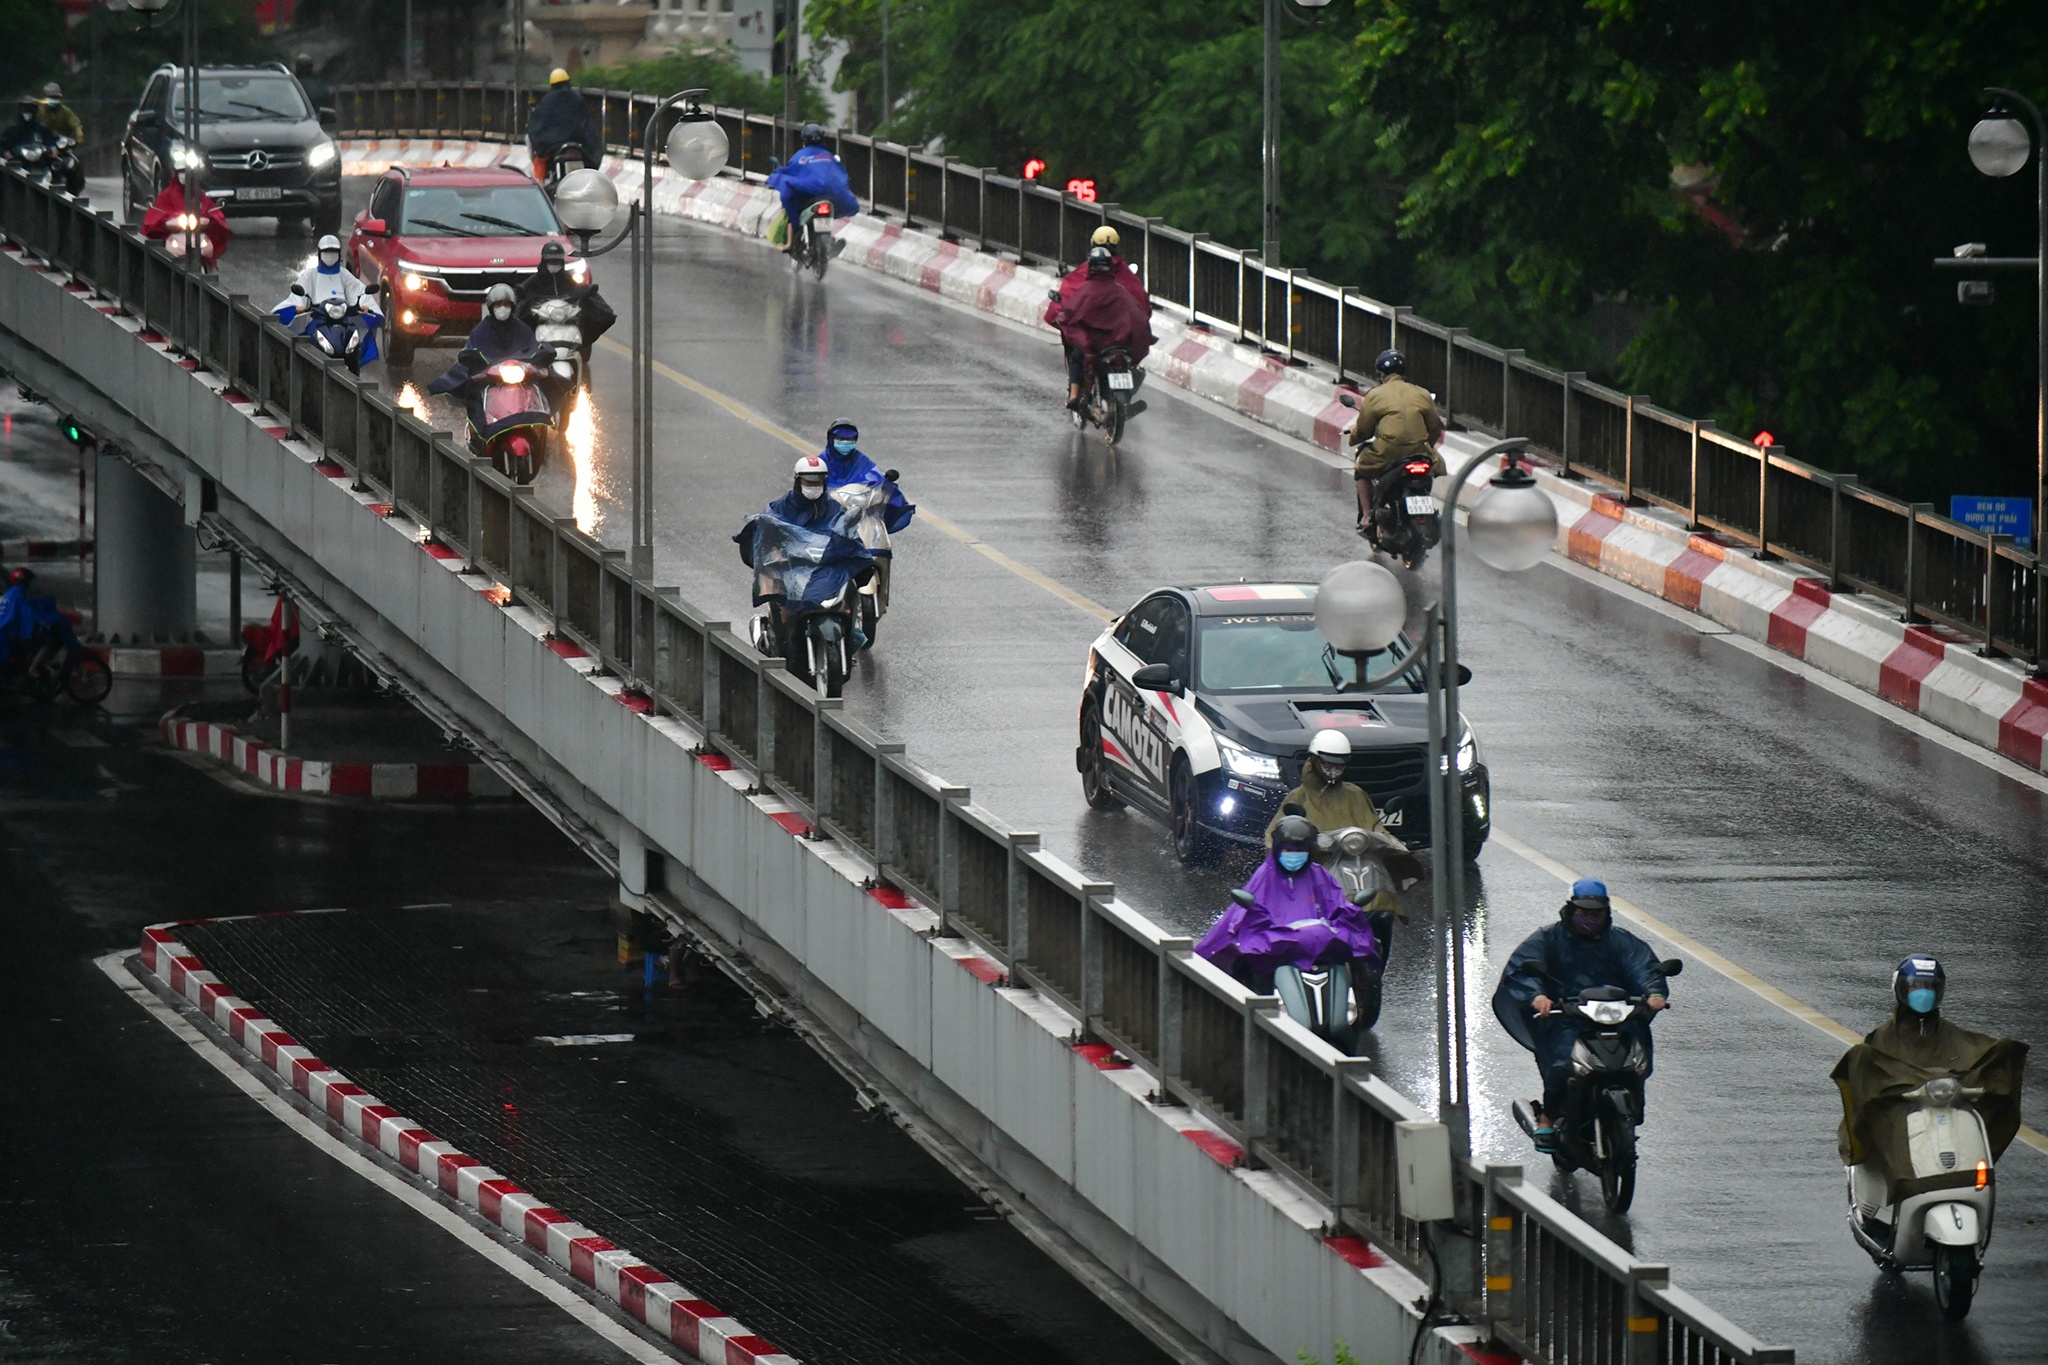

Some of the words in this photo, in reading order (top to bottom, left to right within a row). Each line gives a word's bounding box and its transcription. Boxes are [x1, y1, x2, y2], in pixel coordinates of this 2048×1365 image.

[1067, 178, 1096, 204] 95
[1222, 617, 1260, 625] JVC
[1103, 683, 1164, 784] CAMOZZI
